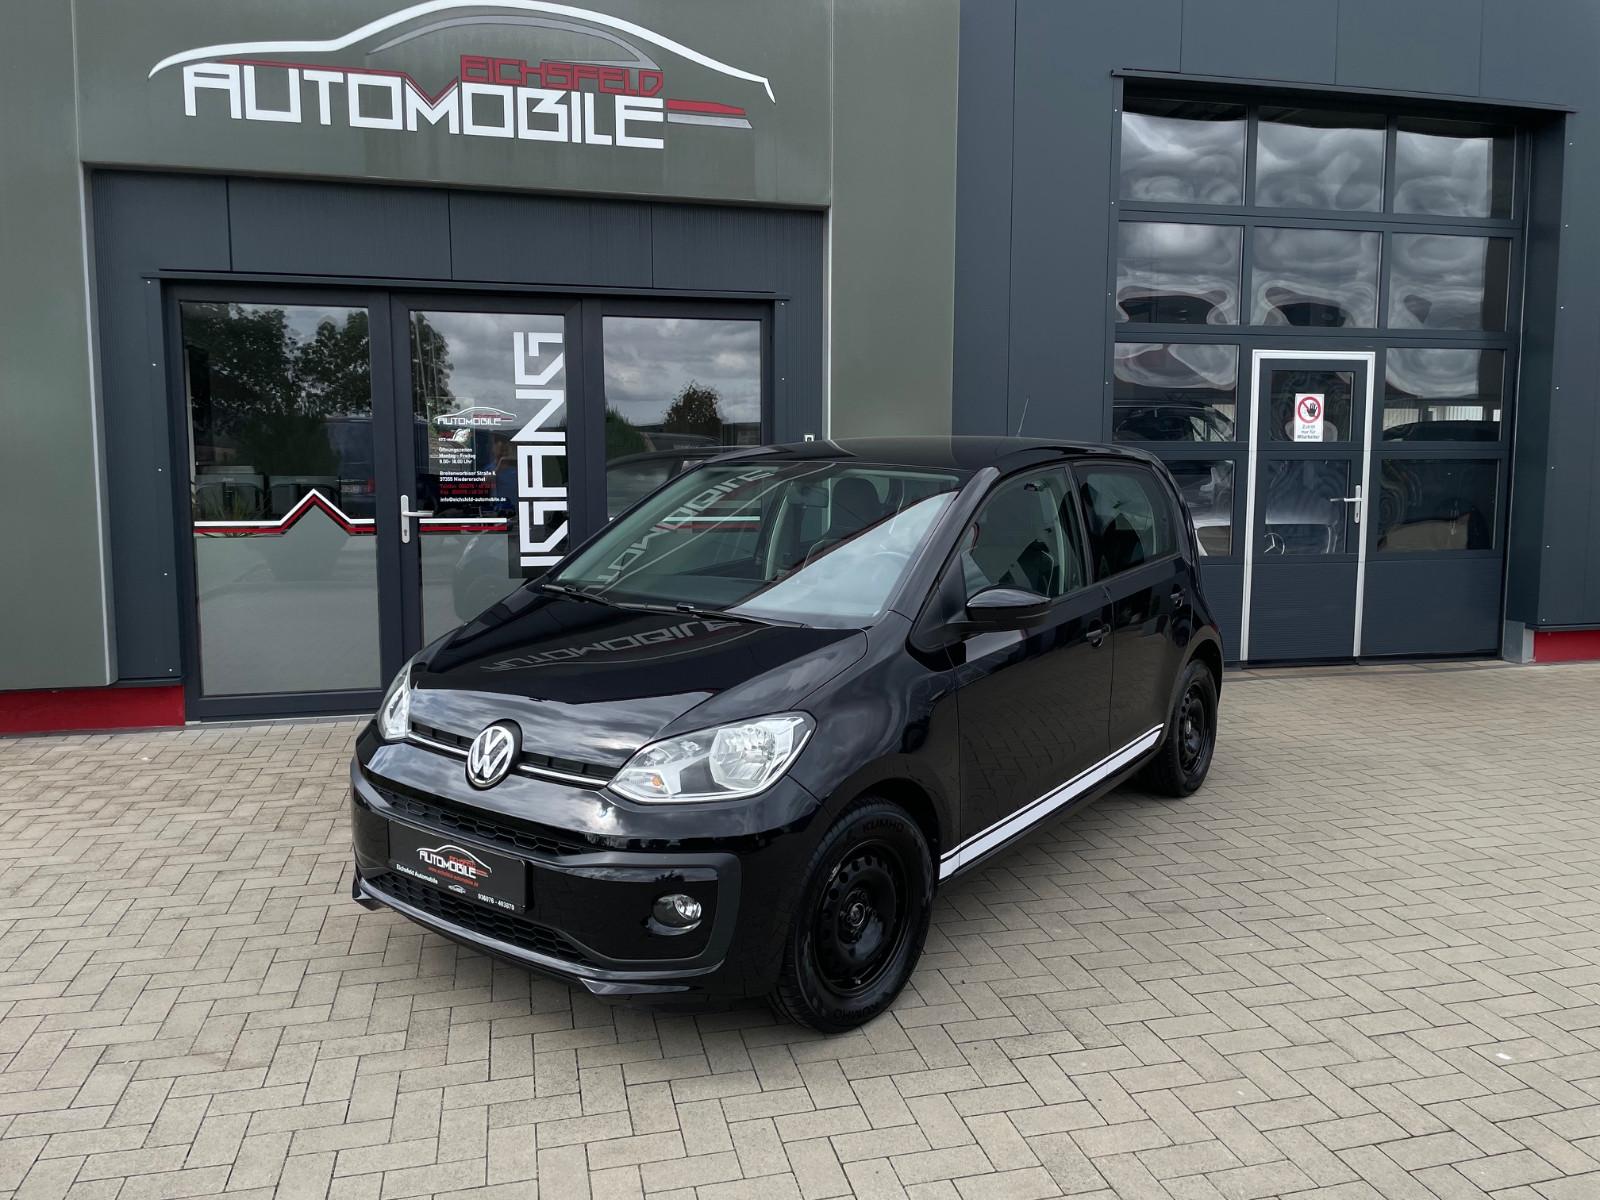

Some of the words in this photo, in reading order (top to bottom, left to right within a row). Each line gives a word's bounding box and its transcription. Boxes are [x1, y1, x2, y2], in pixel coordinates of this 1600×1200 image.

[460, 55, 663, 97] EICHSFELD
[183, 62, 664, 149] AUTOMOBILE
[437, 418, 502, 426] AUTOMOBILE
[467, 726, 514, 787] VW
[863, 818, 905, 833] KUMHO
[415, 871, 438, 884] Automobile
[419, 851, 477, 879] AUTOMOBILE
